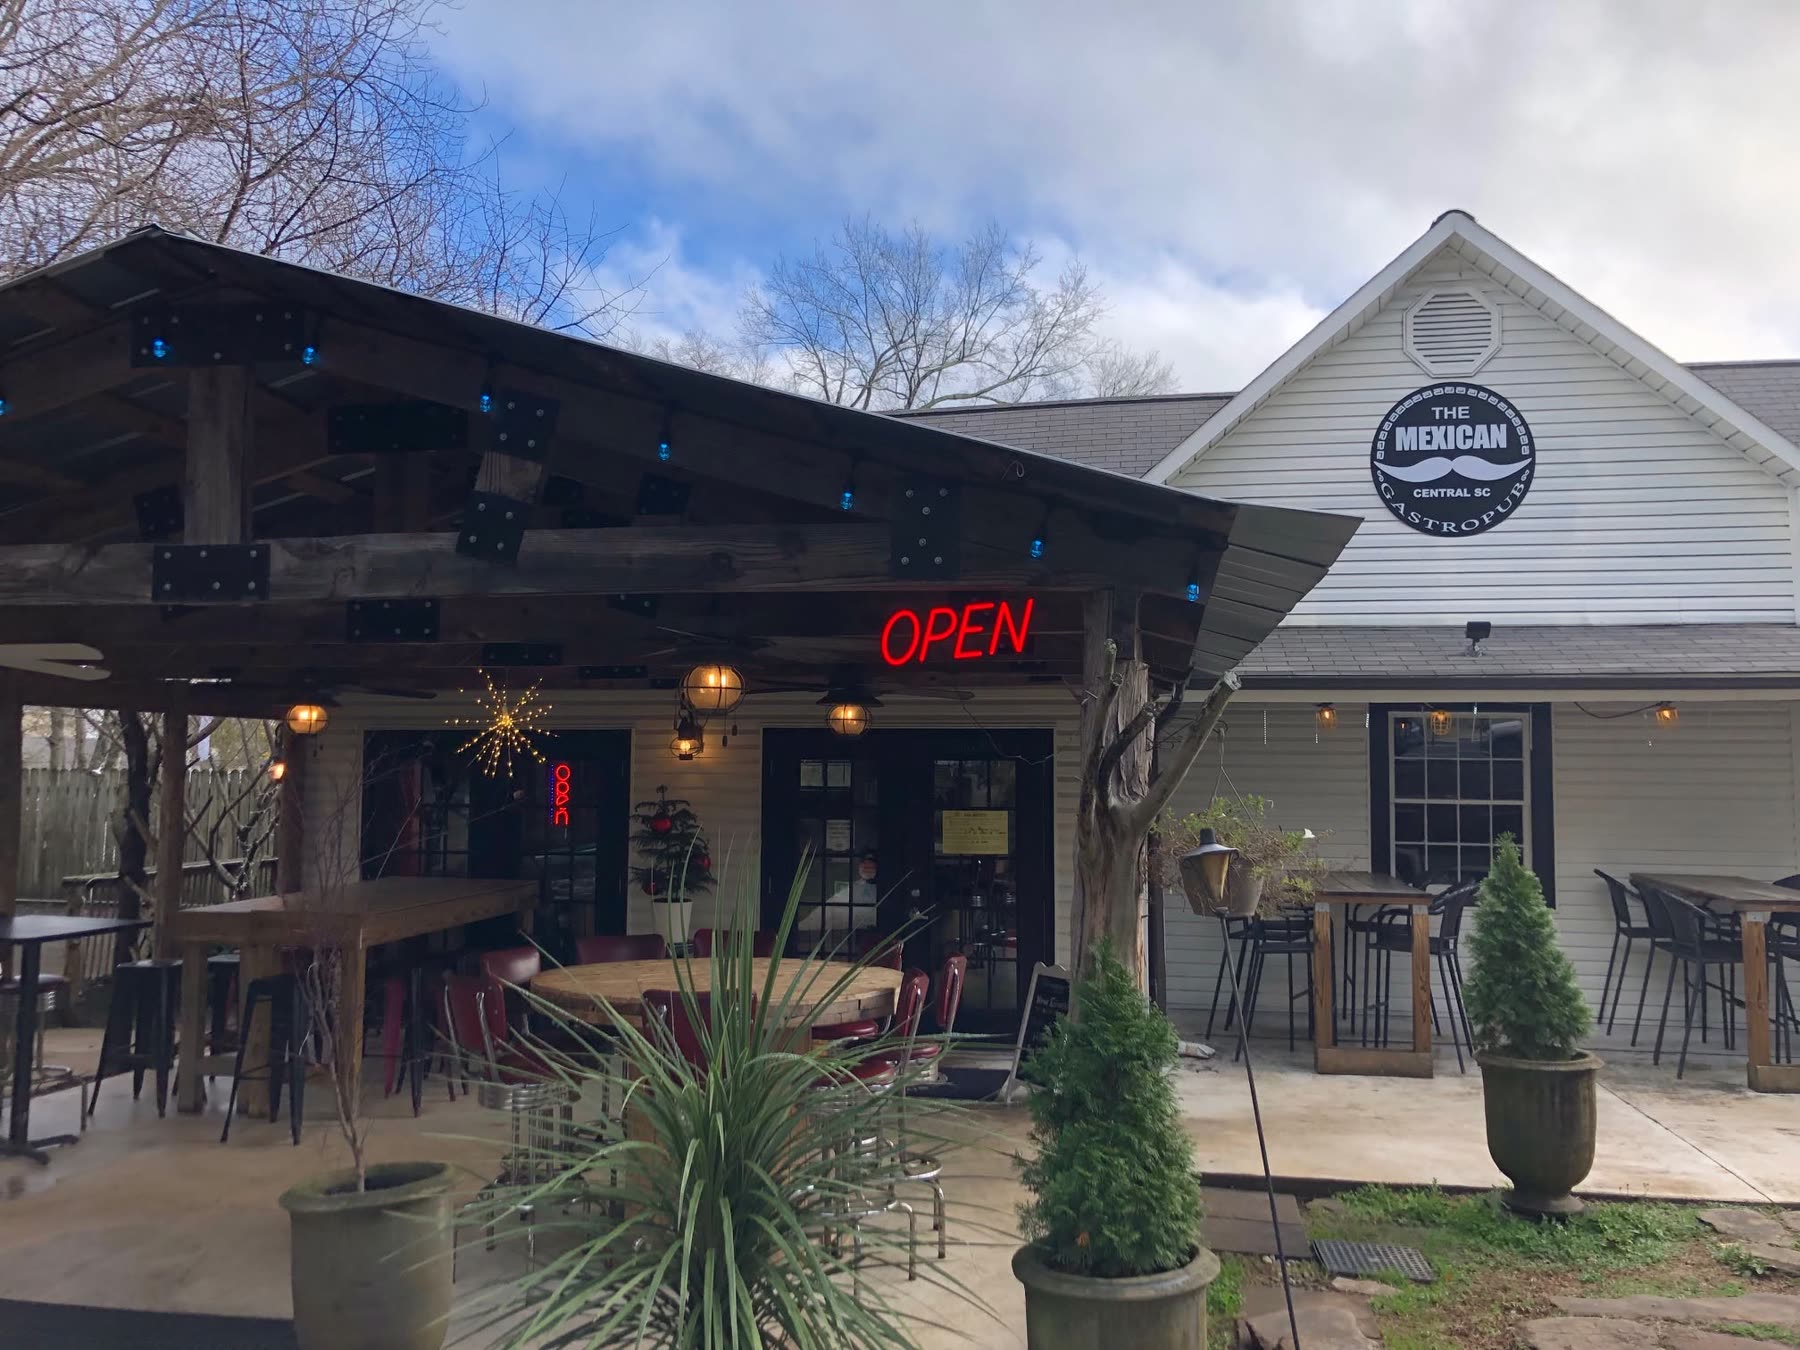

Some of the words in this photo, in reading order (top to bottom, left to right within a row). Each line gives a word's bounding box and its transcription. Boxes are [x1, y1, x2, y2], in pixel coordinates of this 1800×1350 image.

[1431, 406, 1470, 420] THE
[1395, 424, 1507, 451] MEXICAN
[1413, 488, 1471, 498] CENTRAL
[1474, 487, 1491, 497] SC
[1380, 482, 1525, 533] GASTROPUB
[880, 598, 1034, 667] OPEN
